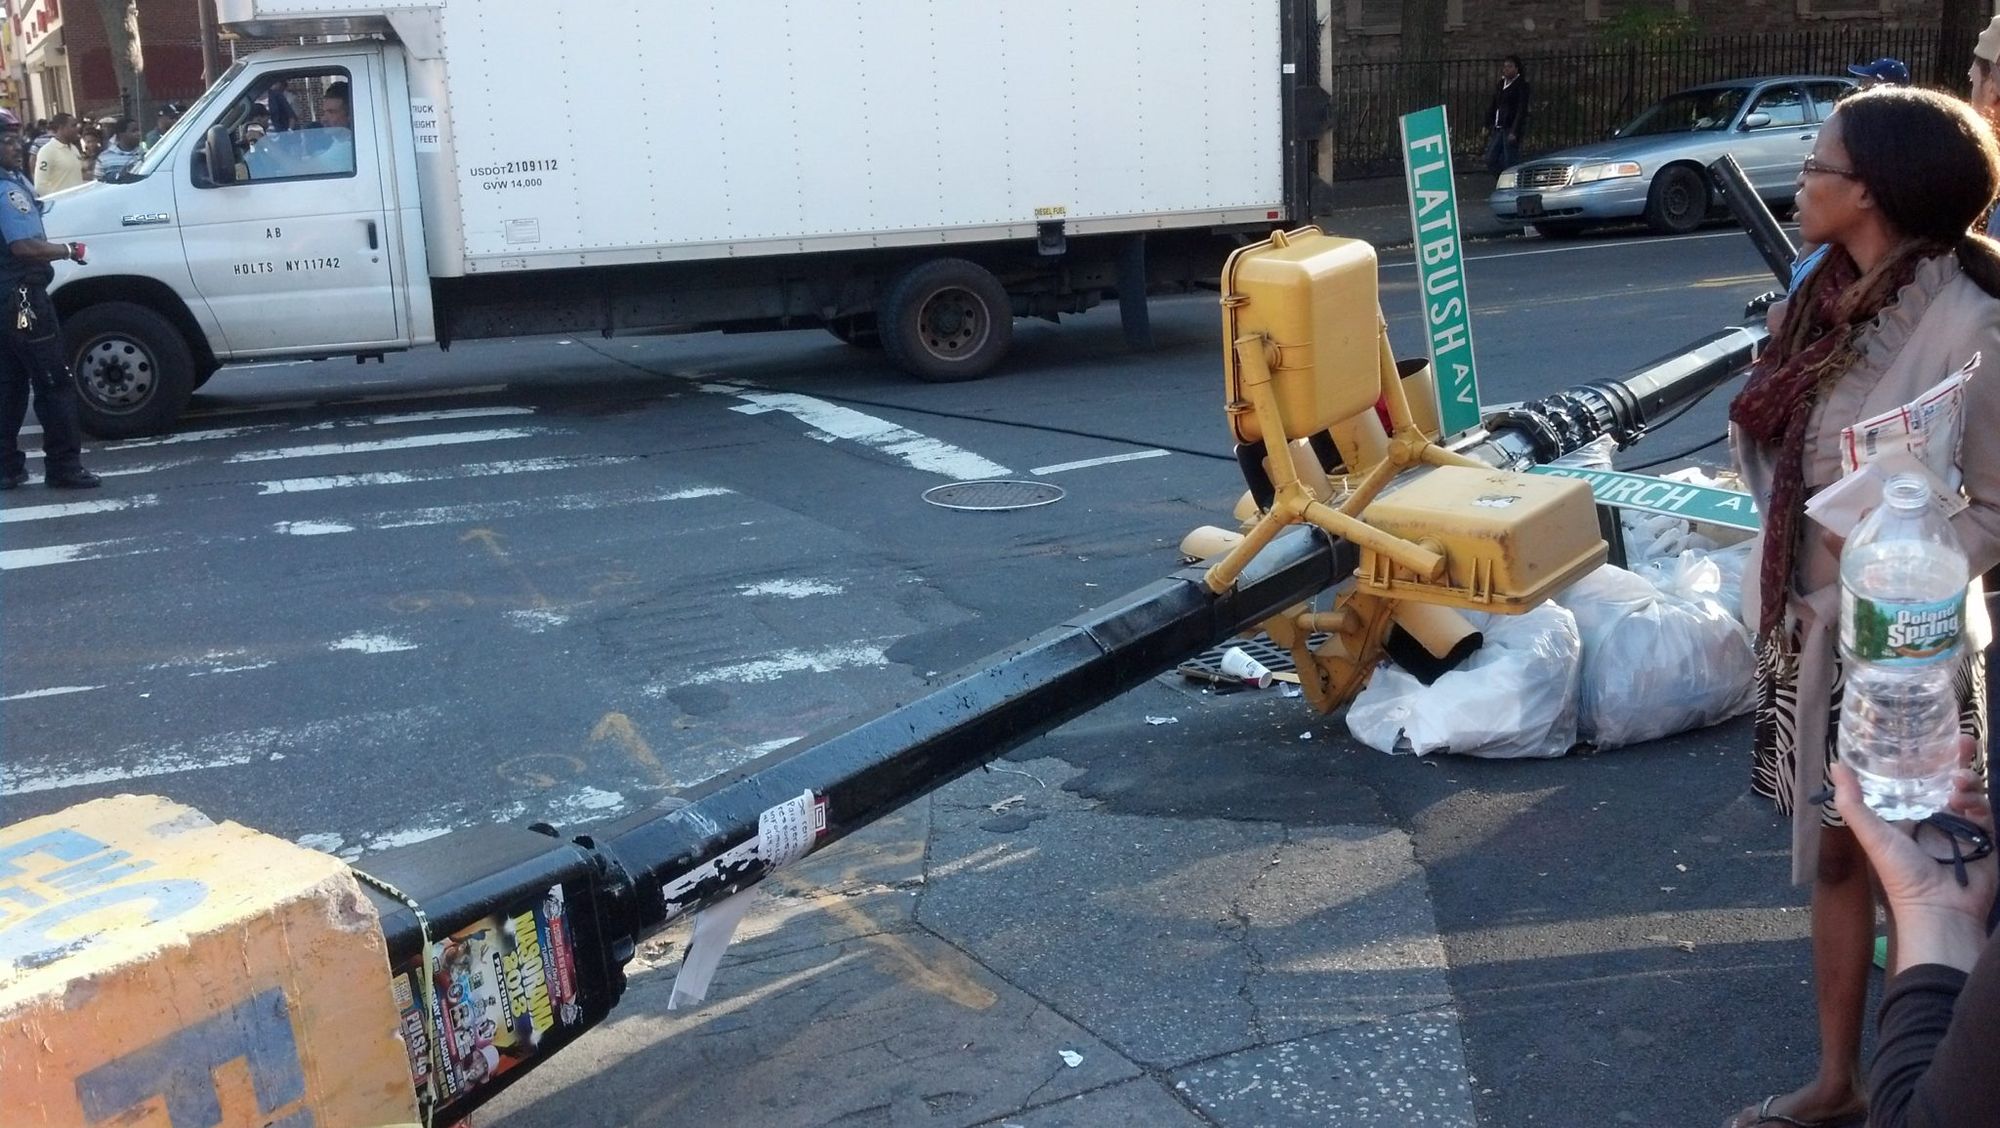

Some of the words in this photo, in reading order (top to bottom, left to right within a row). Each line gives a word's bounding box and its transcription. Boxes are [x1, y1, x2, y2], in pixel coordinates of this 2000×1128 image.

[420, 135, 438, 143] FEET
[40, 161, 47, 171] 2
[483, 180, 508, 190] GVW
[511, 178, 542, 189] 14,000
[1035, 207, 1052, 216] DIESEL
[1053, 206, 1066, 215] FUEL
[234, 262, 274, 275] HOLTS
[1410, 133, 1466, 356] FLATBUSH
[1451, 363, 1473, 403] AV
[1544, 469, 1700, 511] URCH
[1887, 614, 1959, 648] Spring
[1897, 603, 1955, 625] Poland
[502, 953, 527, 1018] 2013
[514, 910, 554, 1032] MASORAMA
[495, 955, 512, 1029] FEATURING
[407, 1011, 427, 1055] PULSE
[440, 1037, 452, 1071] AUGUST
[446, 1071, 457, 1094] 2013
